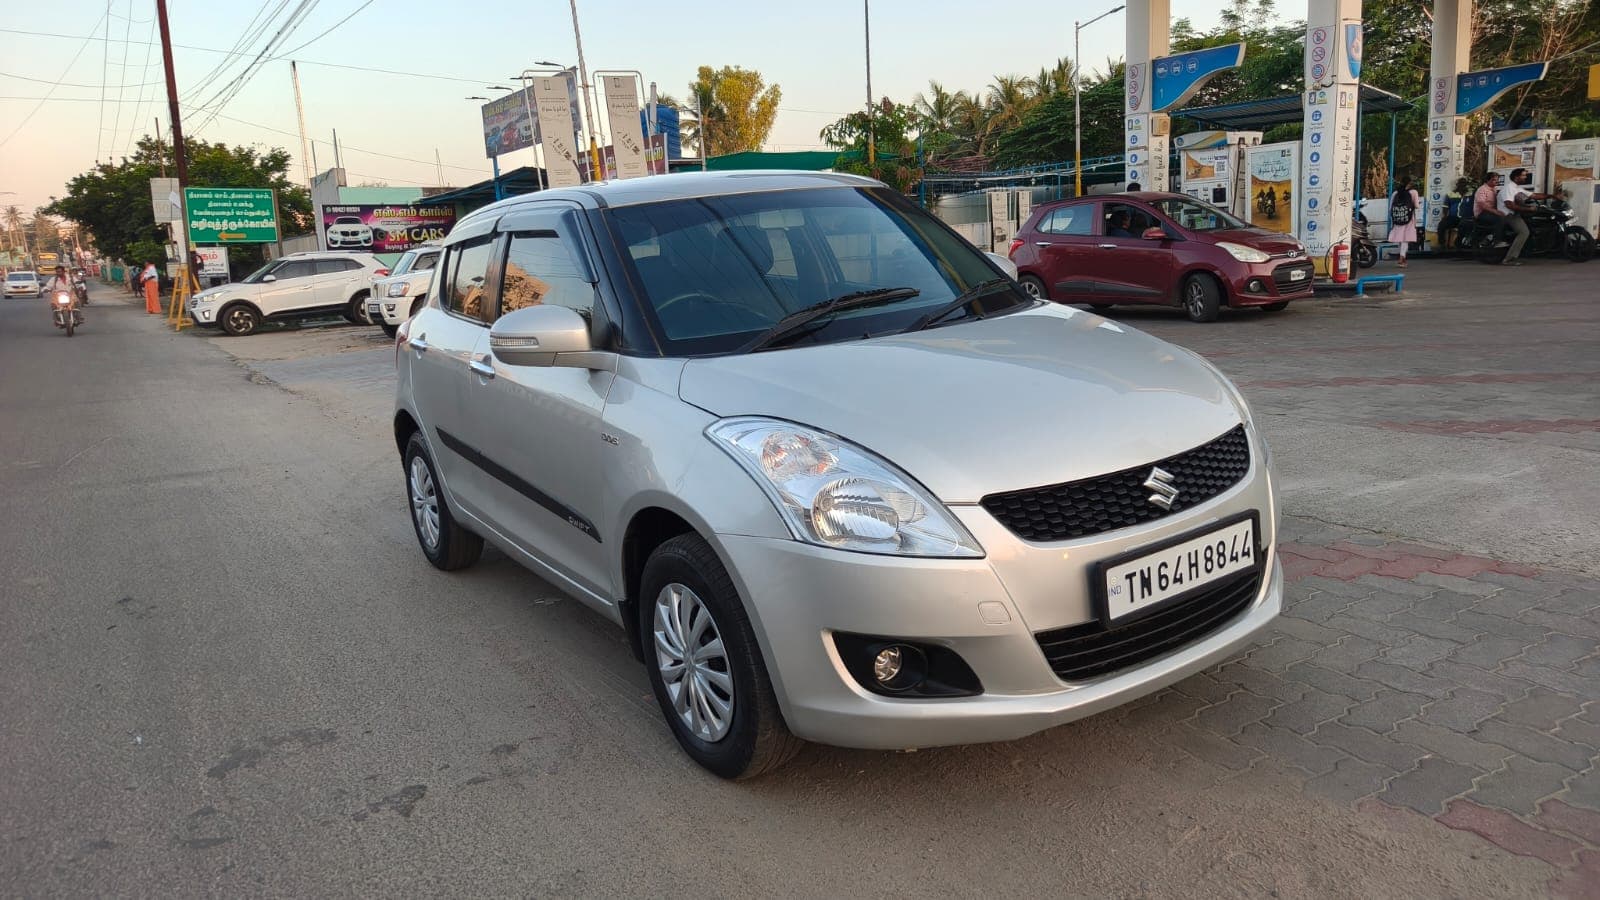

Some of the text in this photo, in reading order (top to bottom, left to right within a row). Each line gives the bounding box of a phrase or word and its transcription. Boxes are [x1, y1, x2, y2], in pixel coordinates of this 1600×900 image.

[389, 228, 445, 242] SM CARS
[1108, 585, 1122, 597] IND
